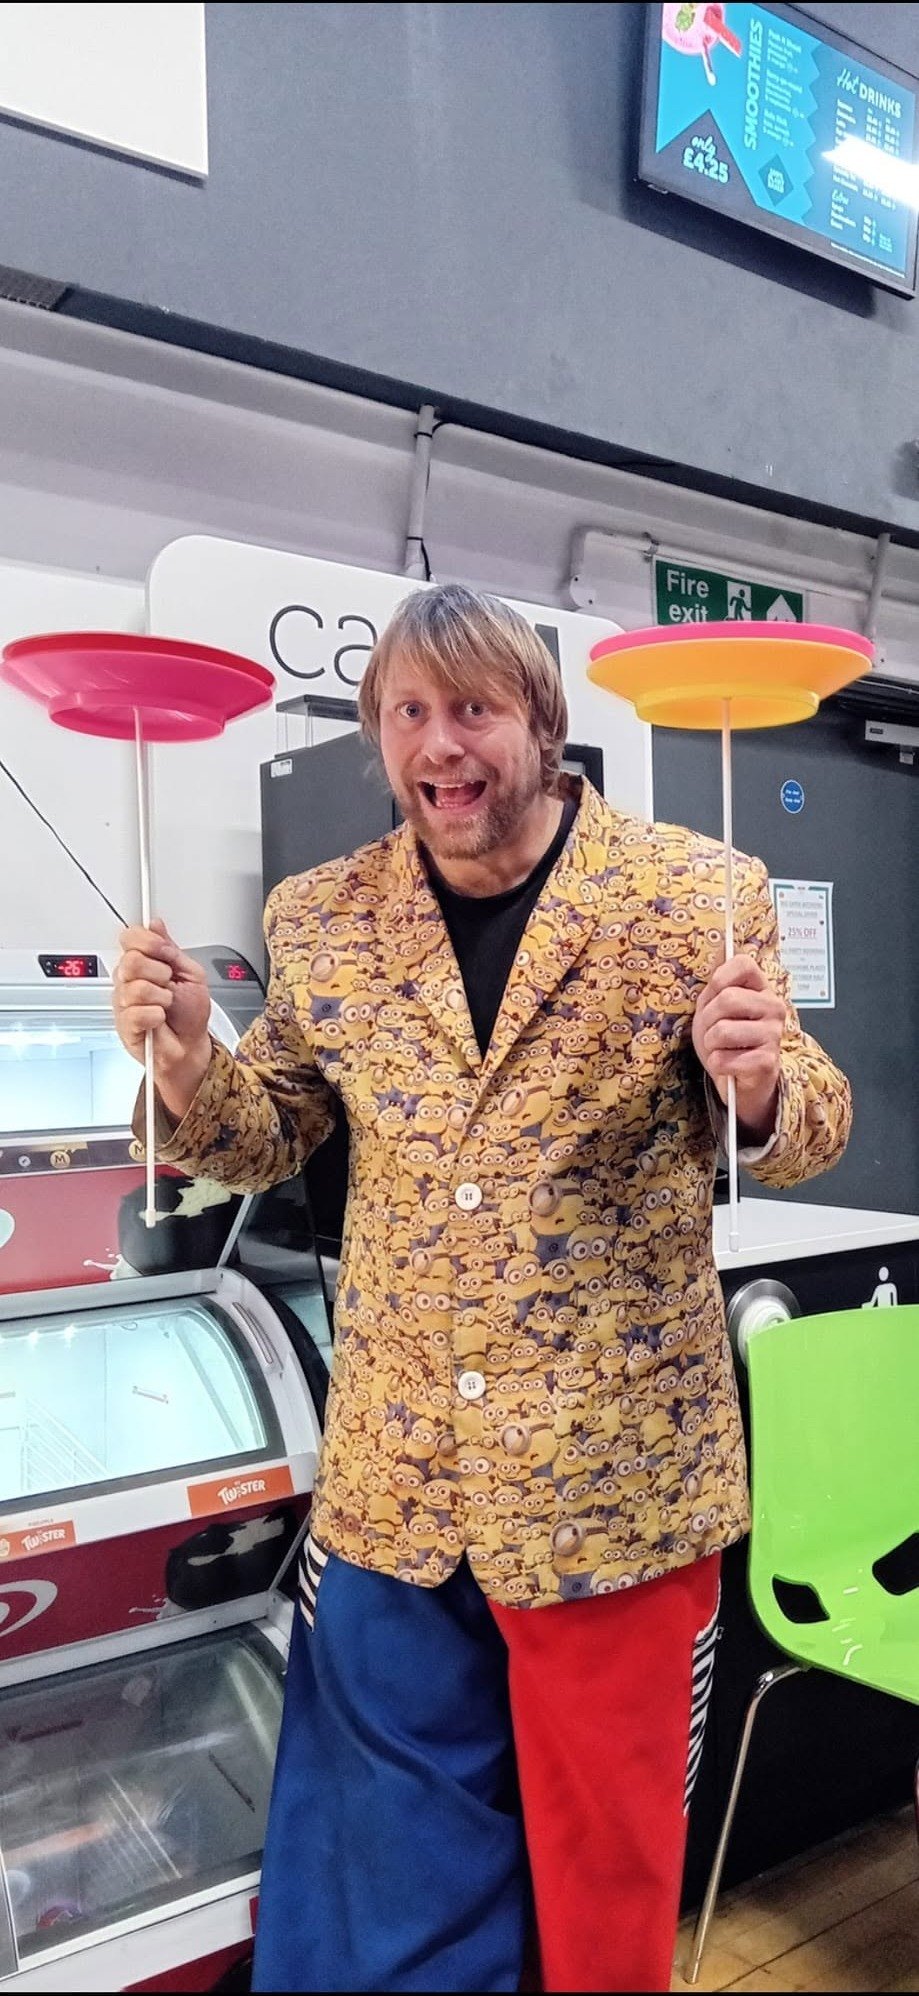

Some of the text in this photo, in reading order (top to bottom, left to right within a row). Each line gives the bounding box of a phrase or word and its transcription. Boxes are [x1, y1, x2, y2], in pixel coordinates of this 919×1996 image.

[744, 19, 763, 150] SMOOTHIES
[837, 68, 860, 95] Hot
[859, 82, 902, 118] DRINKS
[683, 147, 729, 184] £4.25
[666, 569, 710, 598] Fire
[669, 603, 709, 624] exit
